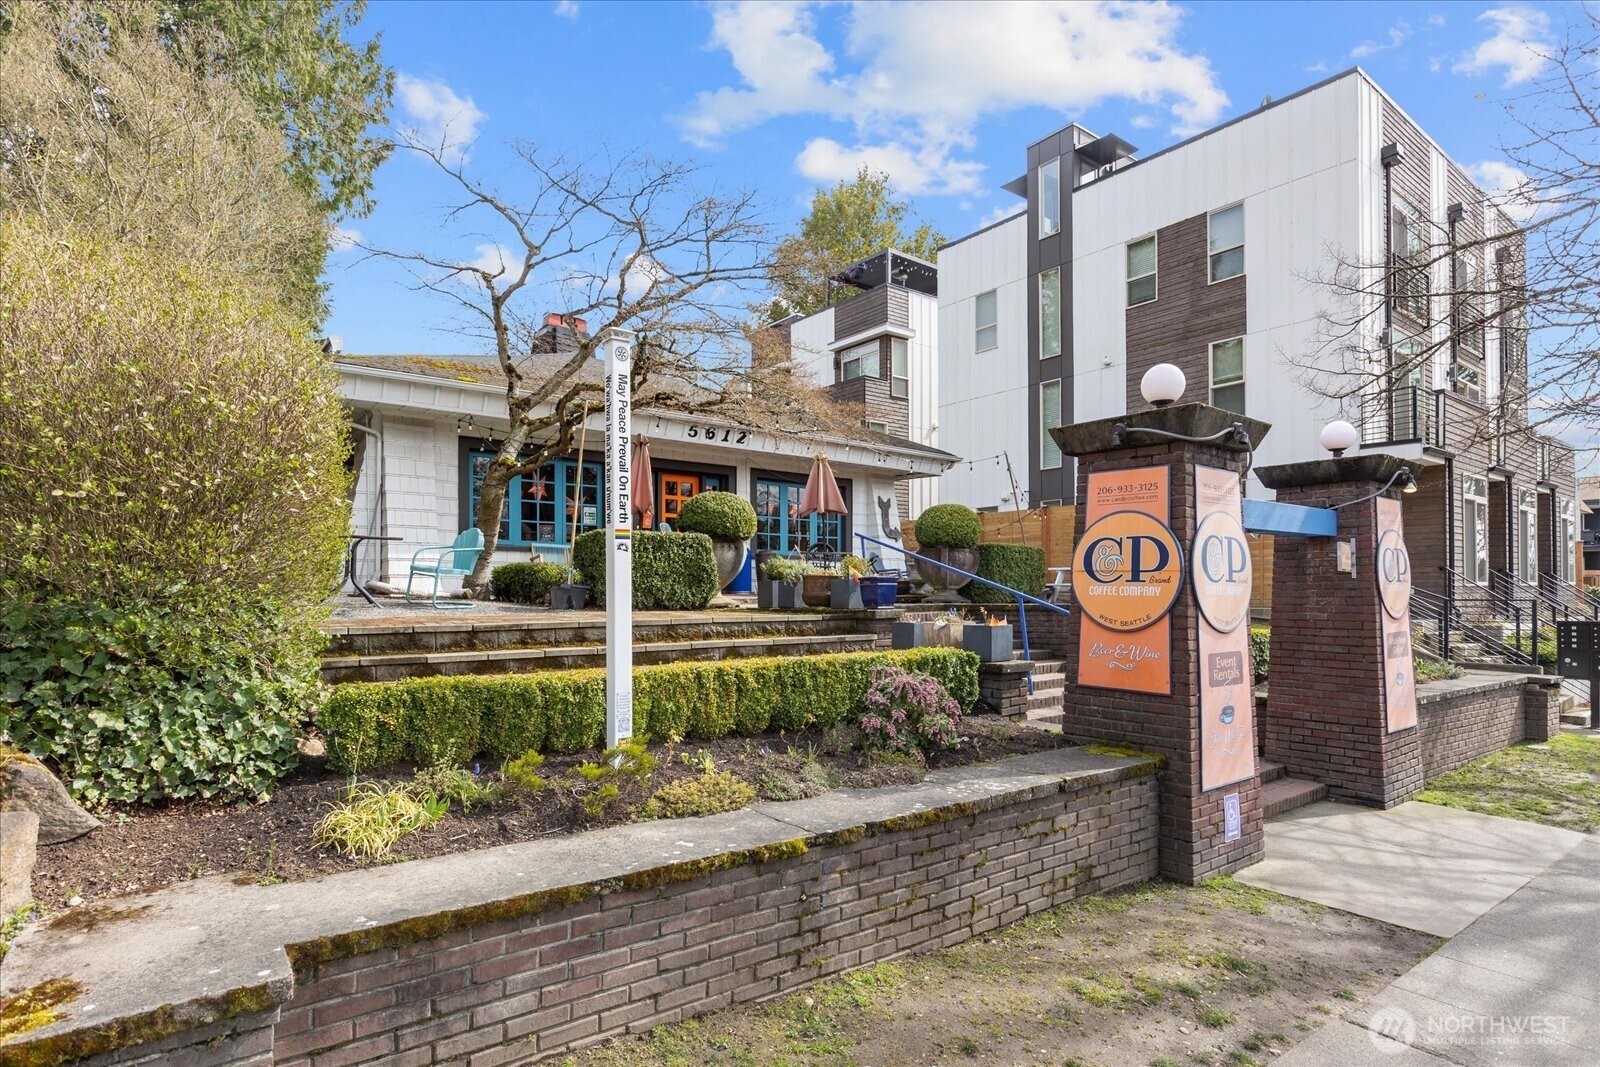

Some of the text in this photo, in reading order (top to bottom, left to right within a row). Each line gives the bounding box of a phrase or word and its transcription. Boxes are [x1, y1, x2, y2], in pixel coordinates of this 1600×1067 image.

[687, 425, 747, 444] 5612
[616, 374, 629, 524] May Peace Prevail On Earth
[1096, 482, 1159, 495] 206-933-3125
[1148, 575, 1172, 584] Brand
[1088, 585, 1161, 597] COFFEE COMPANY
[1099, 613, 1152, 627] WEST SEATTLE
[1088, 642, 1114, 658] Beer
[1129, 644, 1161, 661] Wine
[1216, 656, 1237, 668] Event
[1213, 667, 1240, 681] Rentals
